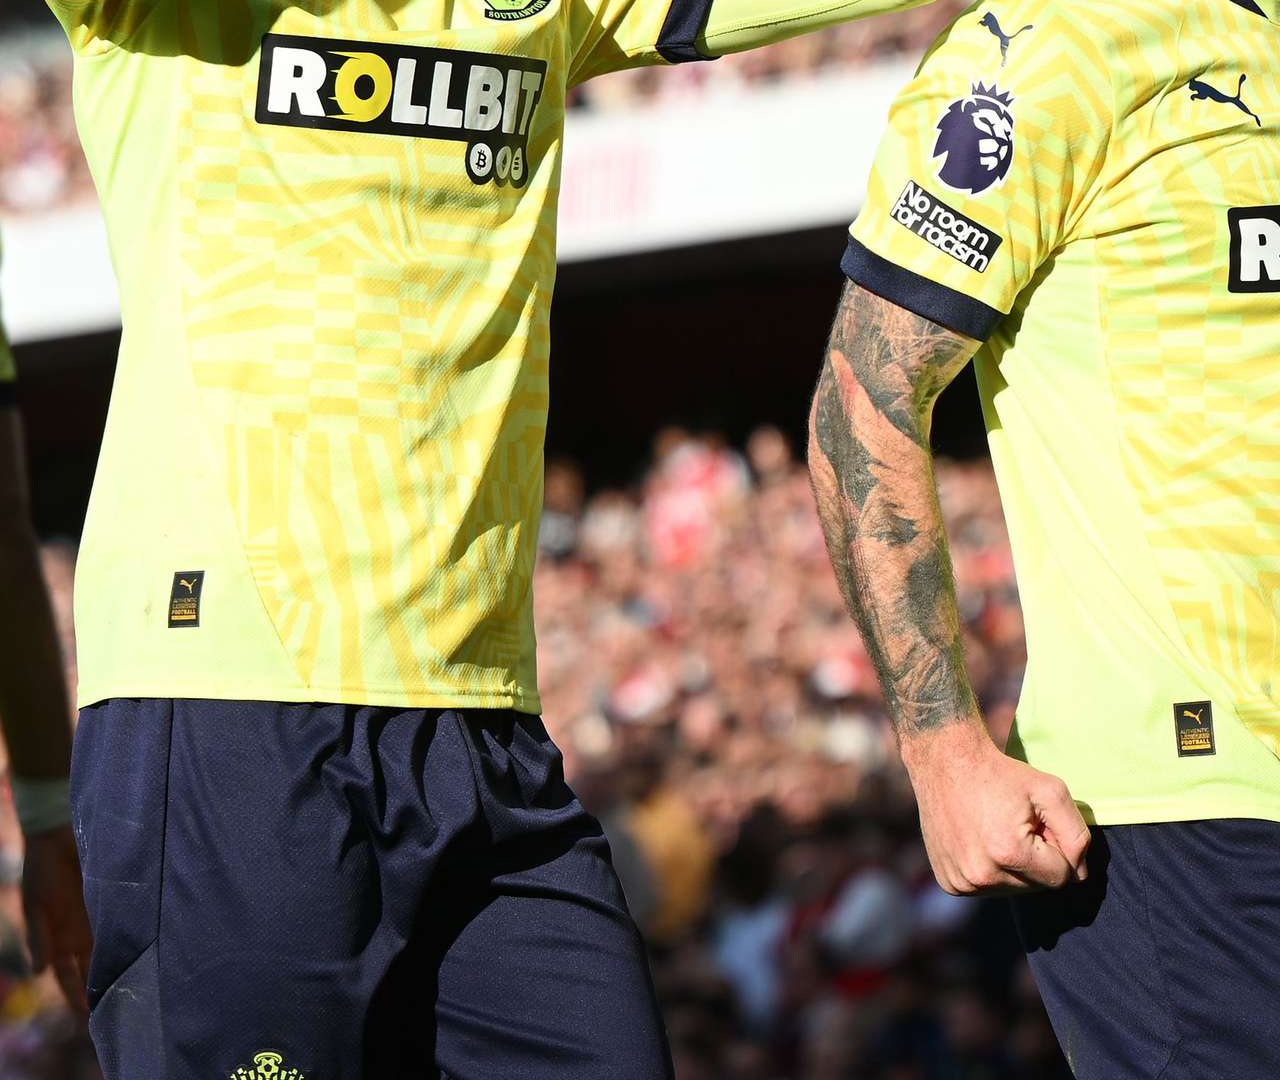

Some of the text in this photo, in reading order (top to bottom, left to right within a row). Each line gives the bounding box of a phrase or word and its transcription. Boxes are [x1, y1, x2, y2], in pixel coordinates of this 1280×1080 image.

[488, 0, 548, 20] SOUTHAMPTON
[267, 46, 542, 135] ROLLBIT
[890, 199, 989, 273] for racism
[900, 180, 990, 251] No room
